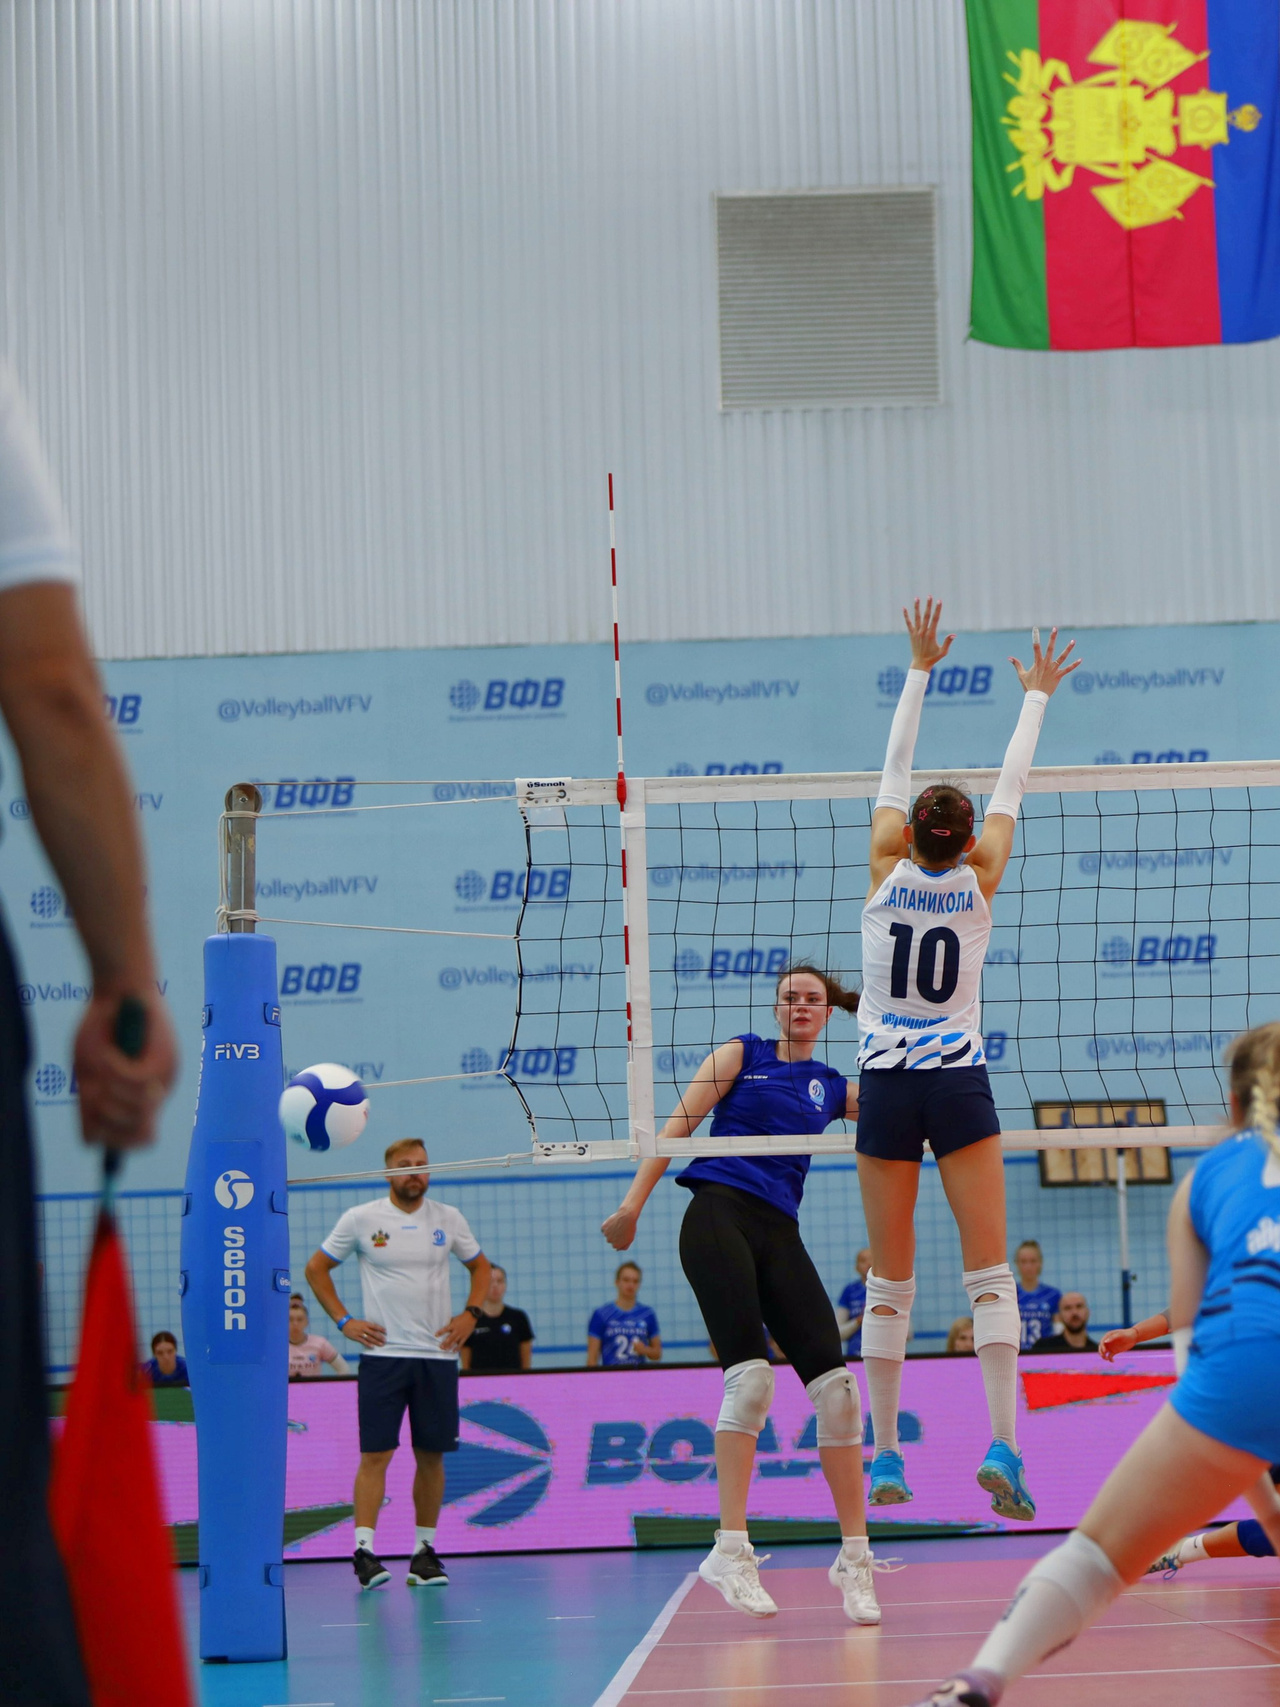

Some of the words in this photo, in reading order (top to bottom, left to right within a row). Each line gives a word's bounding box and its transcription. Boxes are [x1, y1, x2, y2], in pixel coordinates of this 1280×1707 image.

[483, 677, 565, 711] ВФВ
[275, 776, 356, 810] ВФВ
[255, 876, 378, 902] olleyballVFV
[490, 868, 571, 901] ВФВ
[889, 921, 960, 1004] 10
[1137, 934, 1217, 967] ВФВ
[280, 963, 362, 995] ВФВ
[497, 1046, 579, 1078] ВФВ
[1086, 1033, 1235, 1060] @VolleyballVF
[223, 1226, 247, 1330] senoh
[584, 1410, 924, 1485] ВОР
